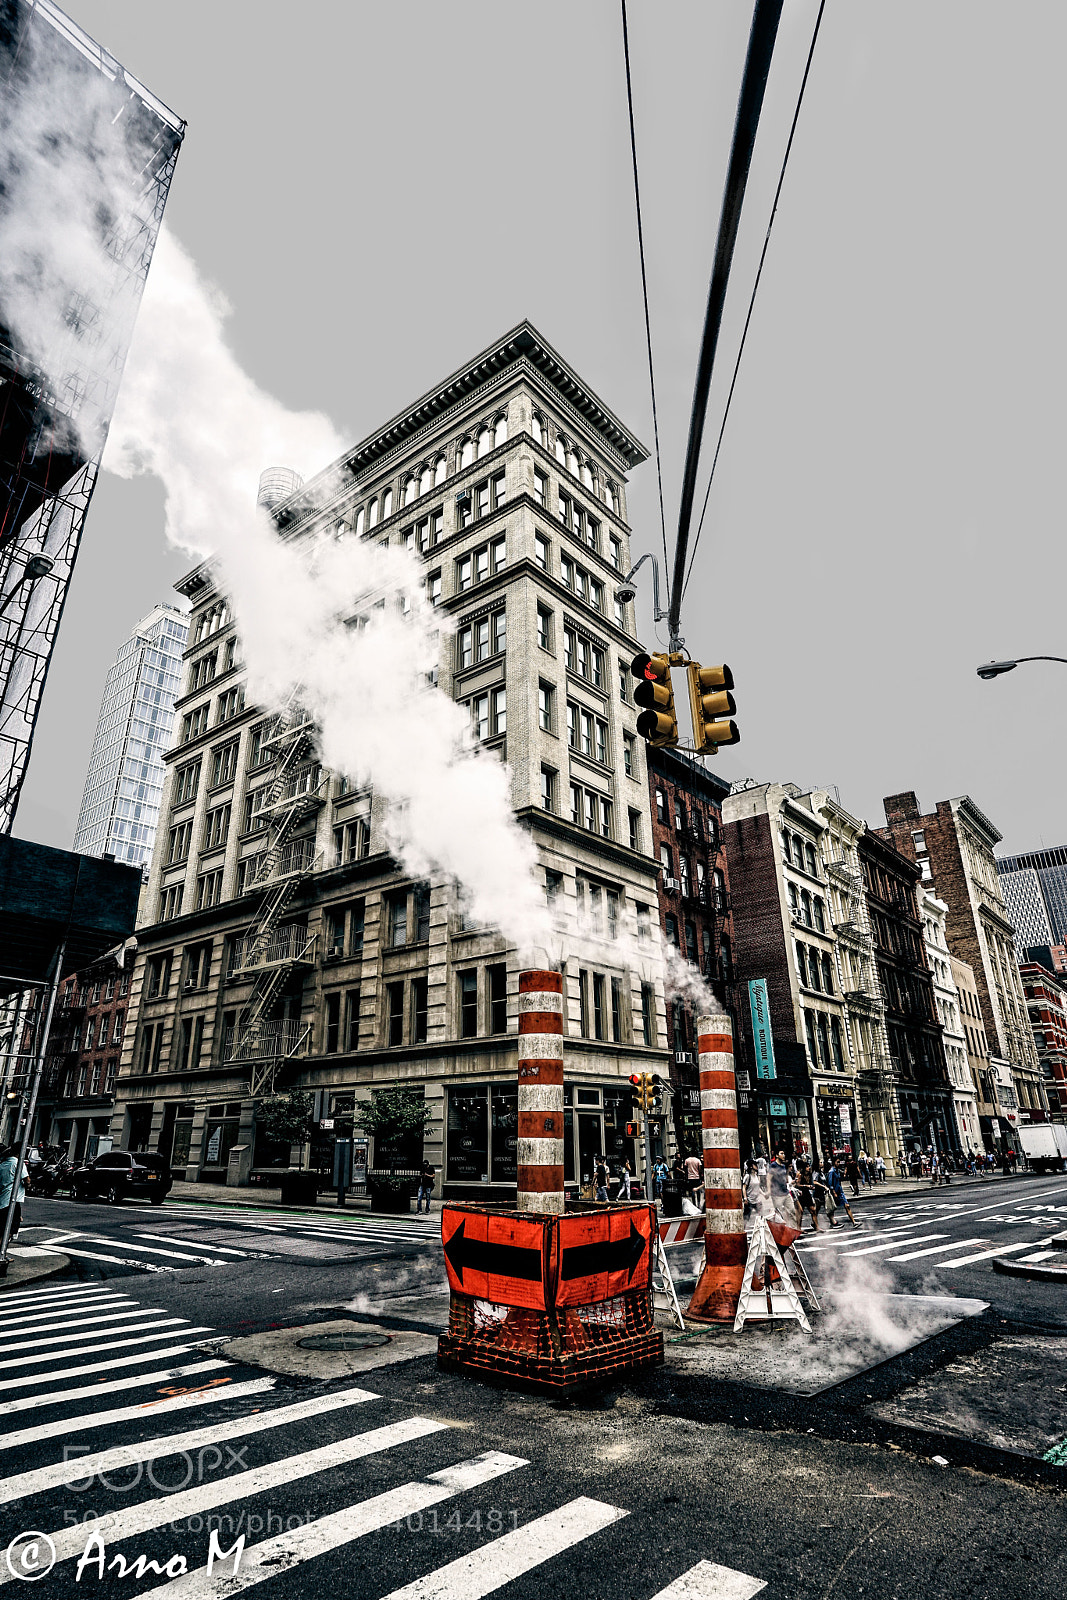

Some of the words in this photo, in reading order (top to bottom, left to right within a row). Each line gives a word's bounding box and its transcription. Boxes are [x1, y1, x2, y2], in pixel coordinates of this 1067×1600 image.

[752, 981, 765, 1024] Mystique
[759, 1029, 768, 1061] BOUTIQUE
[762, 1065, 770, 1079] NYC
